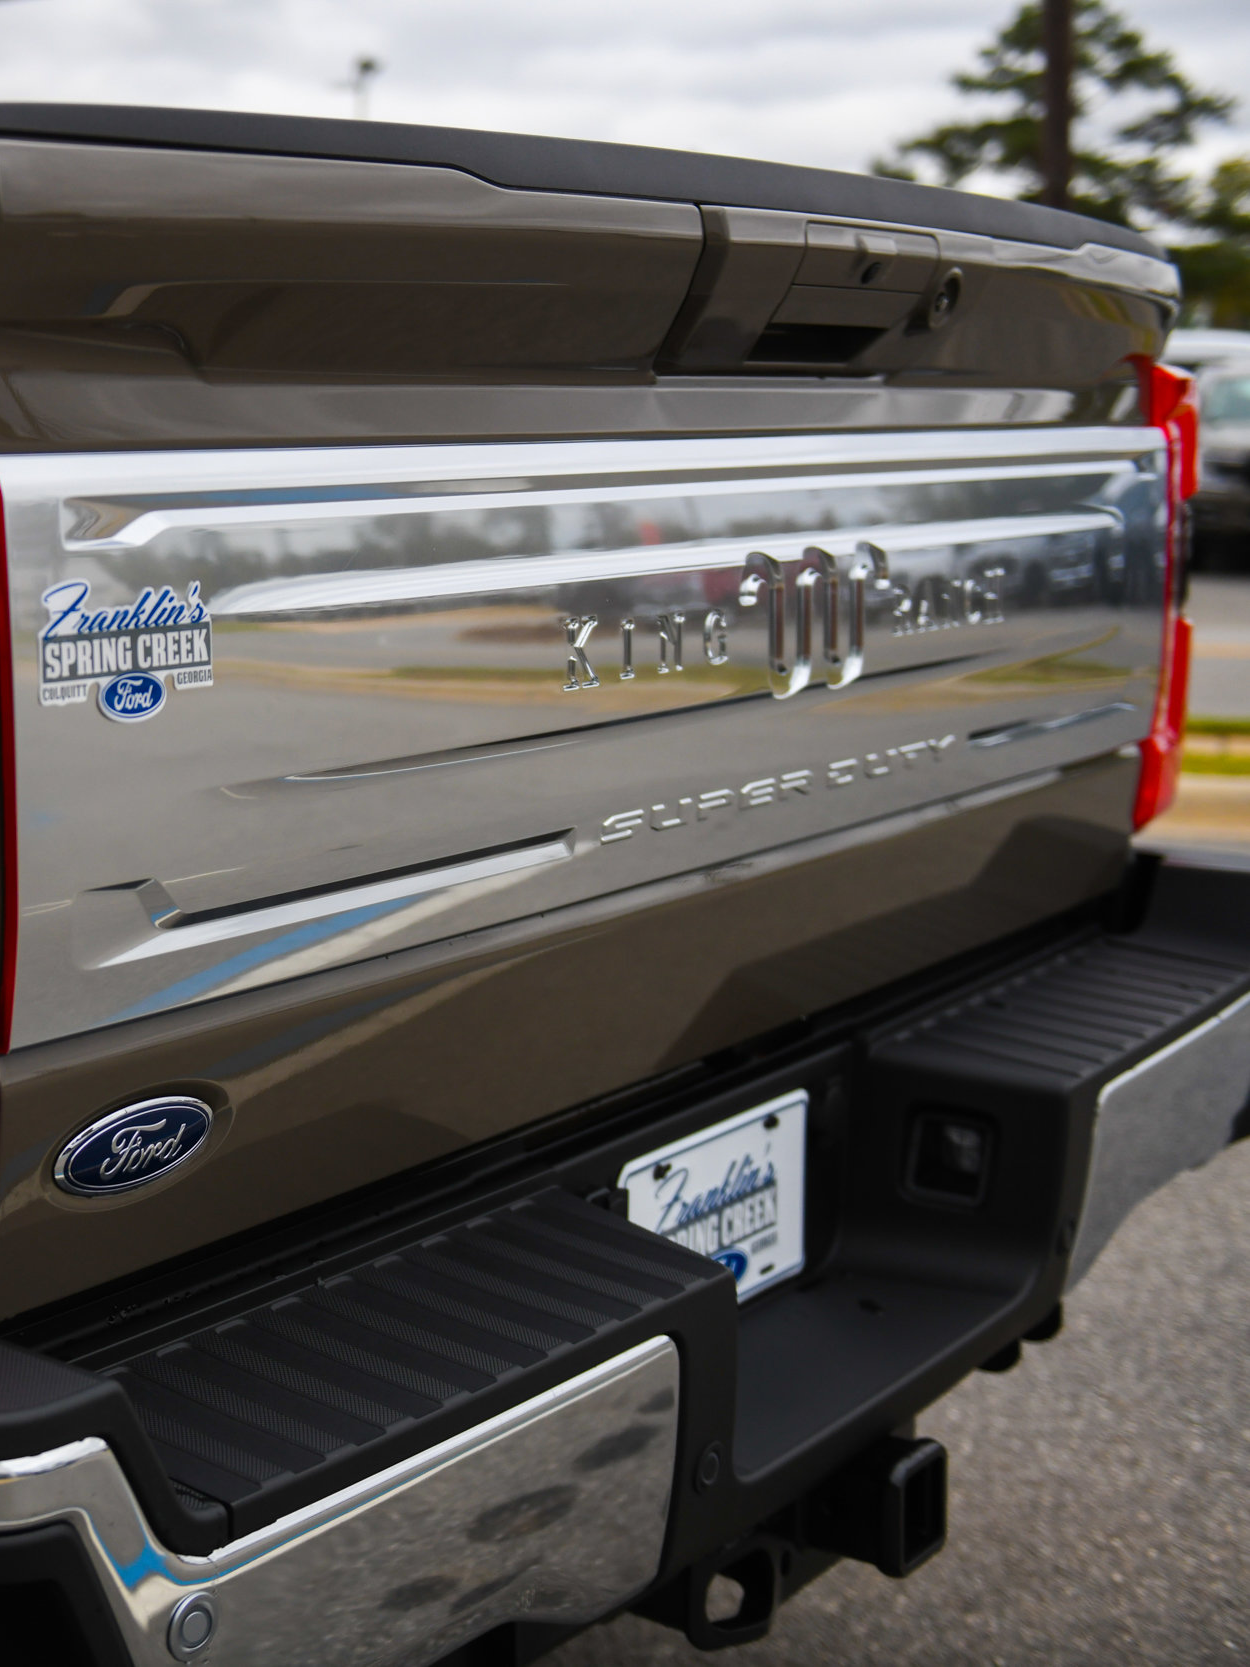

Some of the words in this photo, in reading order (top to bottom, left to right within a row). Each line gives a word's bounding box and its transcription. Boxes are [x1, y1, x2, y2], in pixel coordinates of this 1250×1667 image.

[44, 582, 209, 640] Franklin's
[44, 635, 133, 680] SPRING
[137, 628, 209, 669] CREEK
[177, 669, 213, 686] GEORGIA
[563, 608, 729, 691] KING
[113, 678, 154, 712] Ford
[601, 769, 813, 845] SUPER
[827, 734, 956, 790] DUTY
[100, 1118, 187, 1181] Ford
